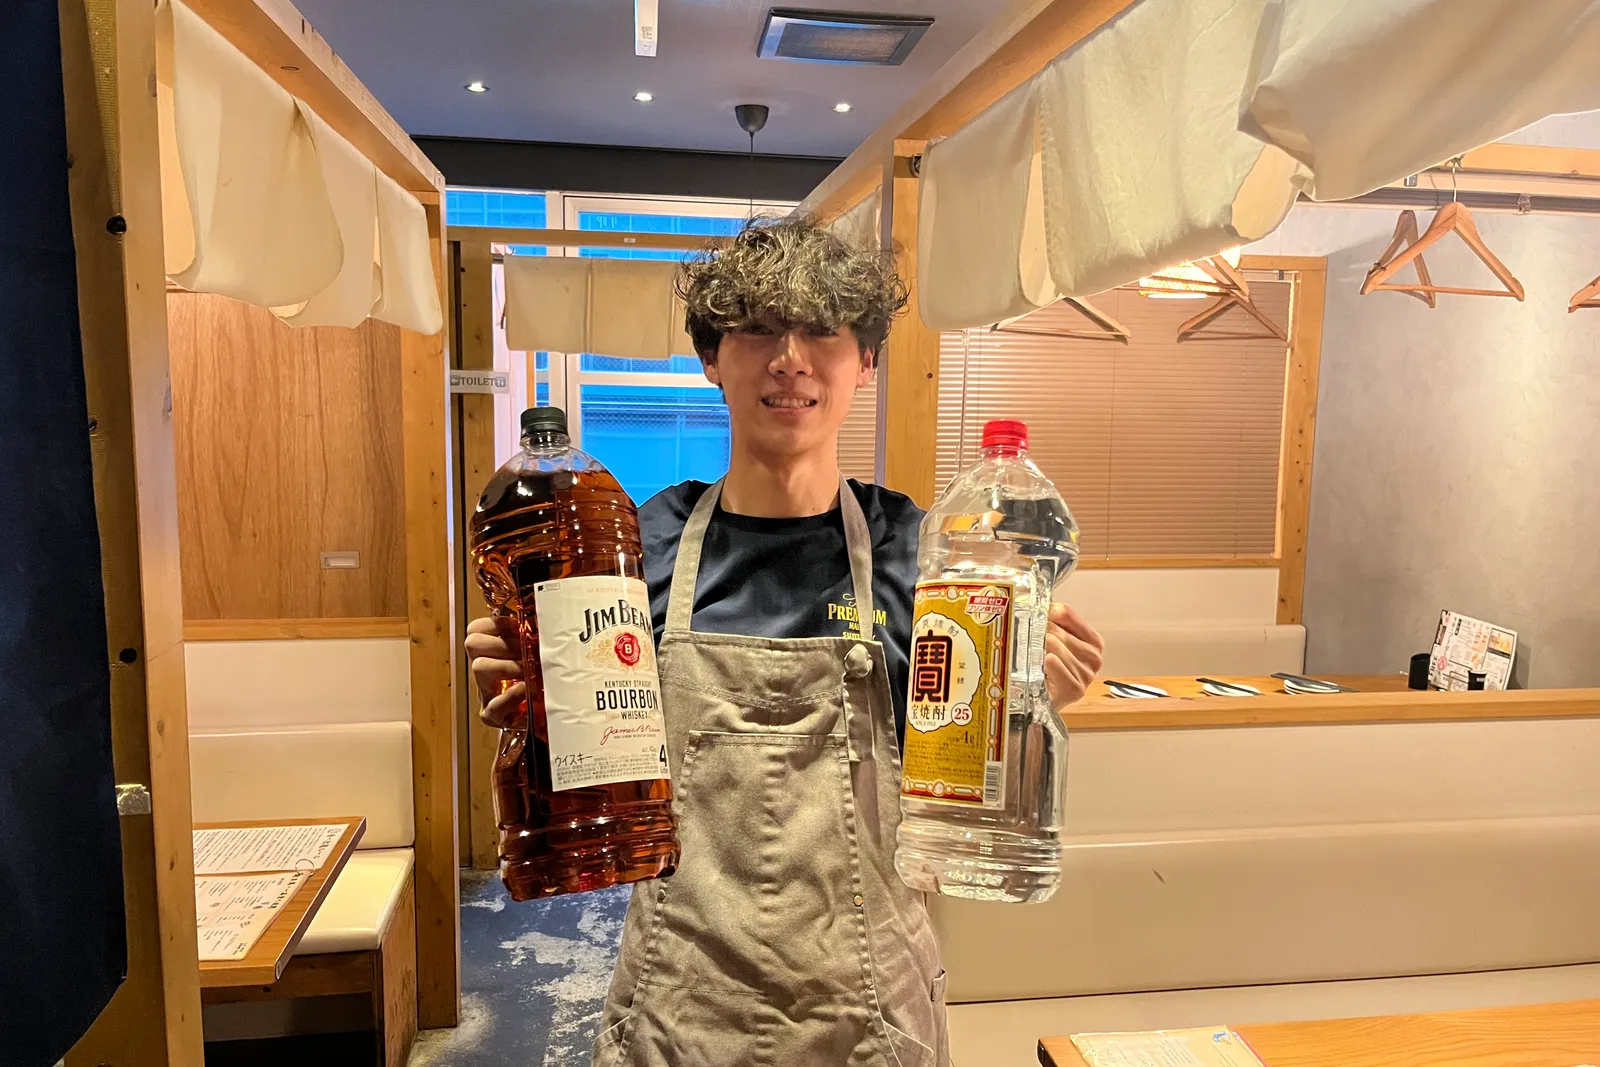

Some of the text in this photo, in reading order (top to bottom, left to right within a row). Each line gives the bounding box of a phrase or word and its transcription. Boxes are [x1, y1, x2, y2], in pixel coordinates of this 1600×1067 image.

[460, 376, 495, 386] TOILET
[579, 606, 618, 644] JIM
[604, 680, 632, 689] KENTUCKY
[595, 688, 659, 712] BOURBON
[621, 710, 648, 720] WHISKEY
[954, 707, 970, 721] 25
[555, 752, 594, 768] ウイスキー
